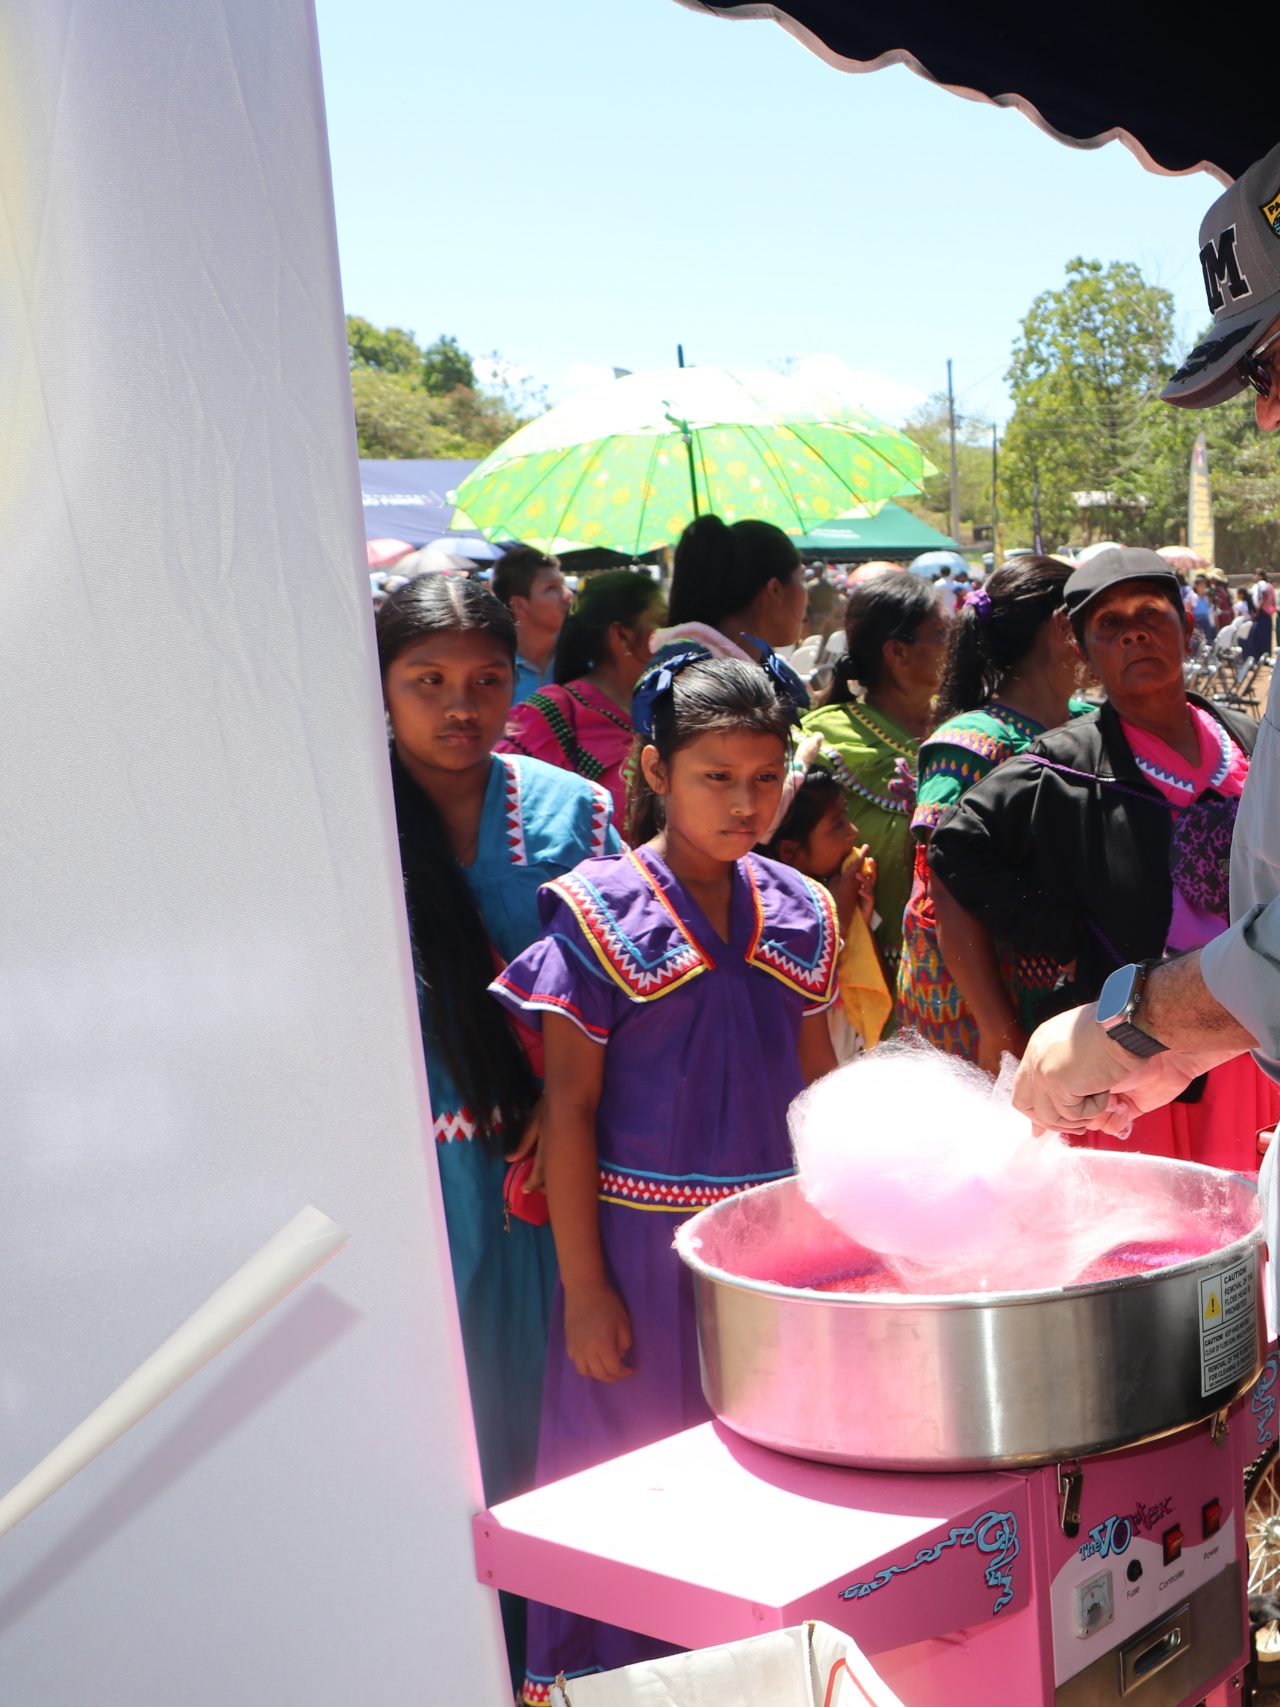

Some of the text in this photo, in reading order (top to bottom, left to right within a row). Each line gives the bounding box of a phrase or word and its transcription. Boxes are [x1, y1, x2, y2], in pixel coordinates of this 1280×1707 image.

[1078, 1538, 1102, 1561] The
[1203, 1546, 1220, 1561] Power
[1158, 1567, 1185, 1592] Controller
[1126, 1585, 1141, 1600] Fuse
